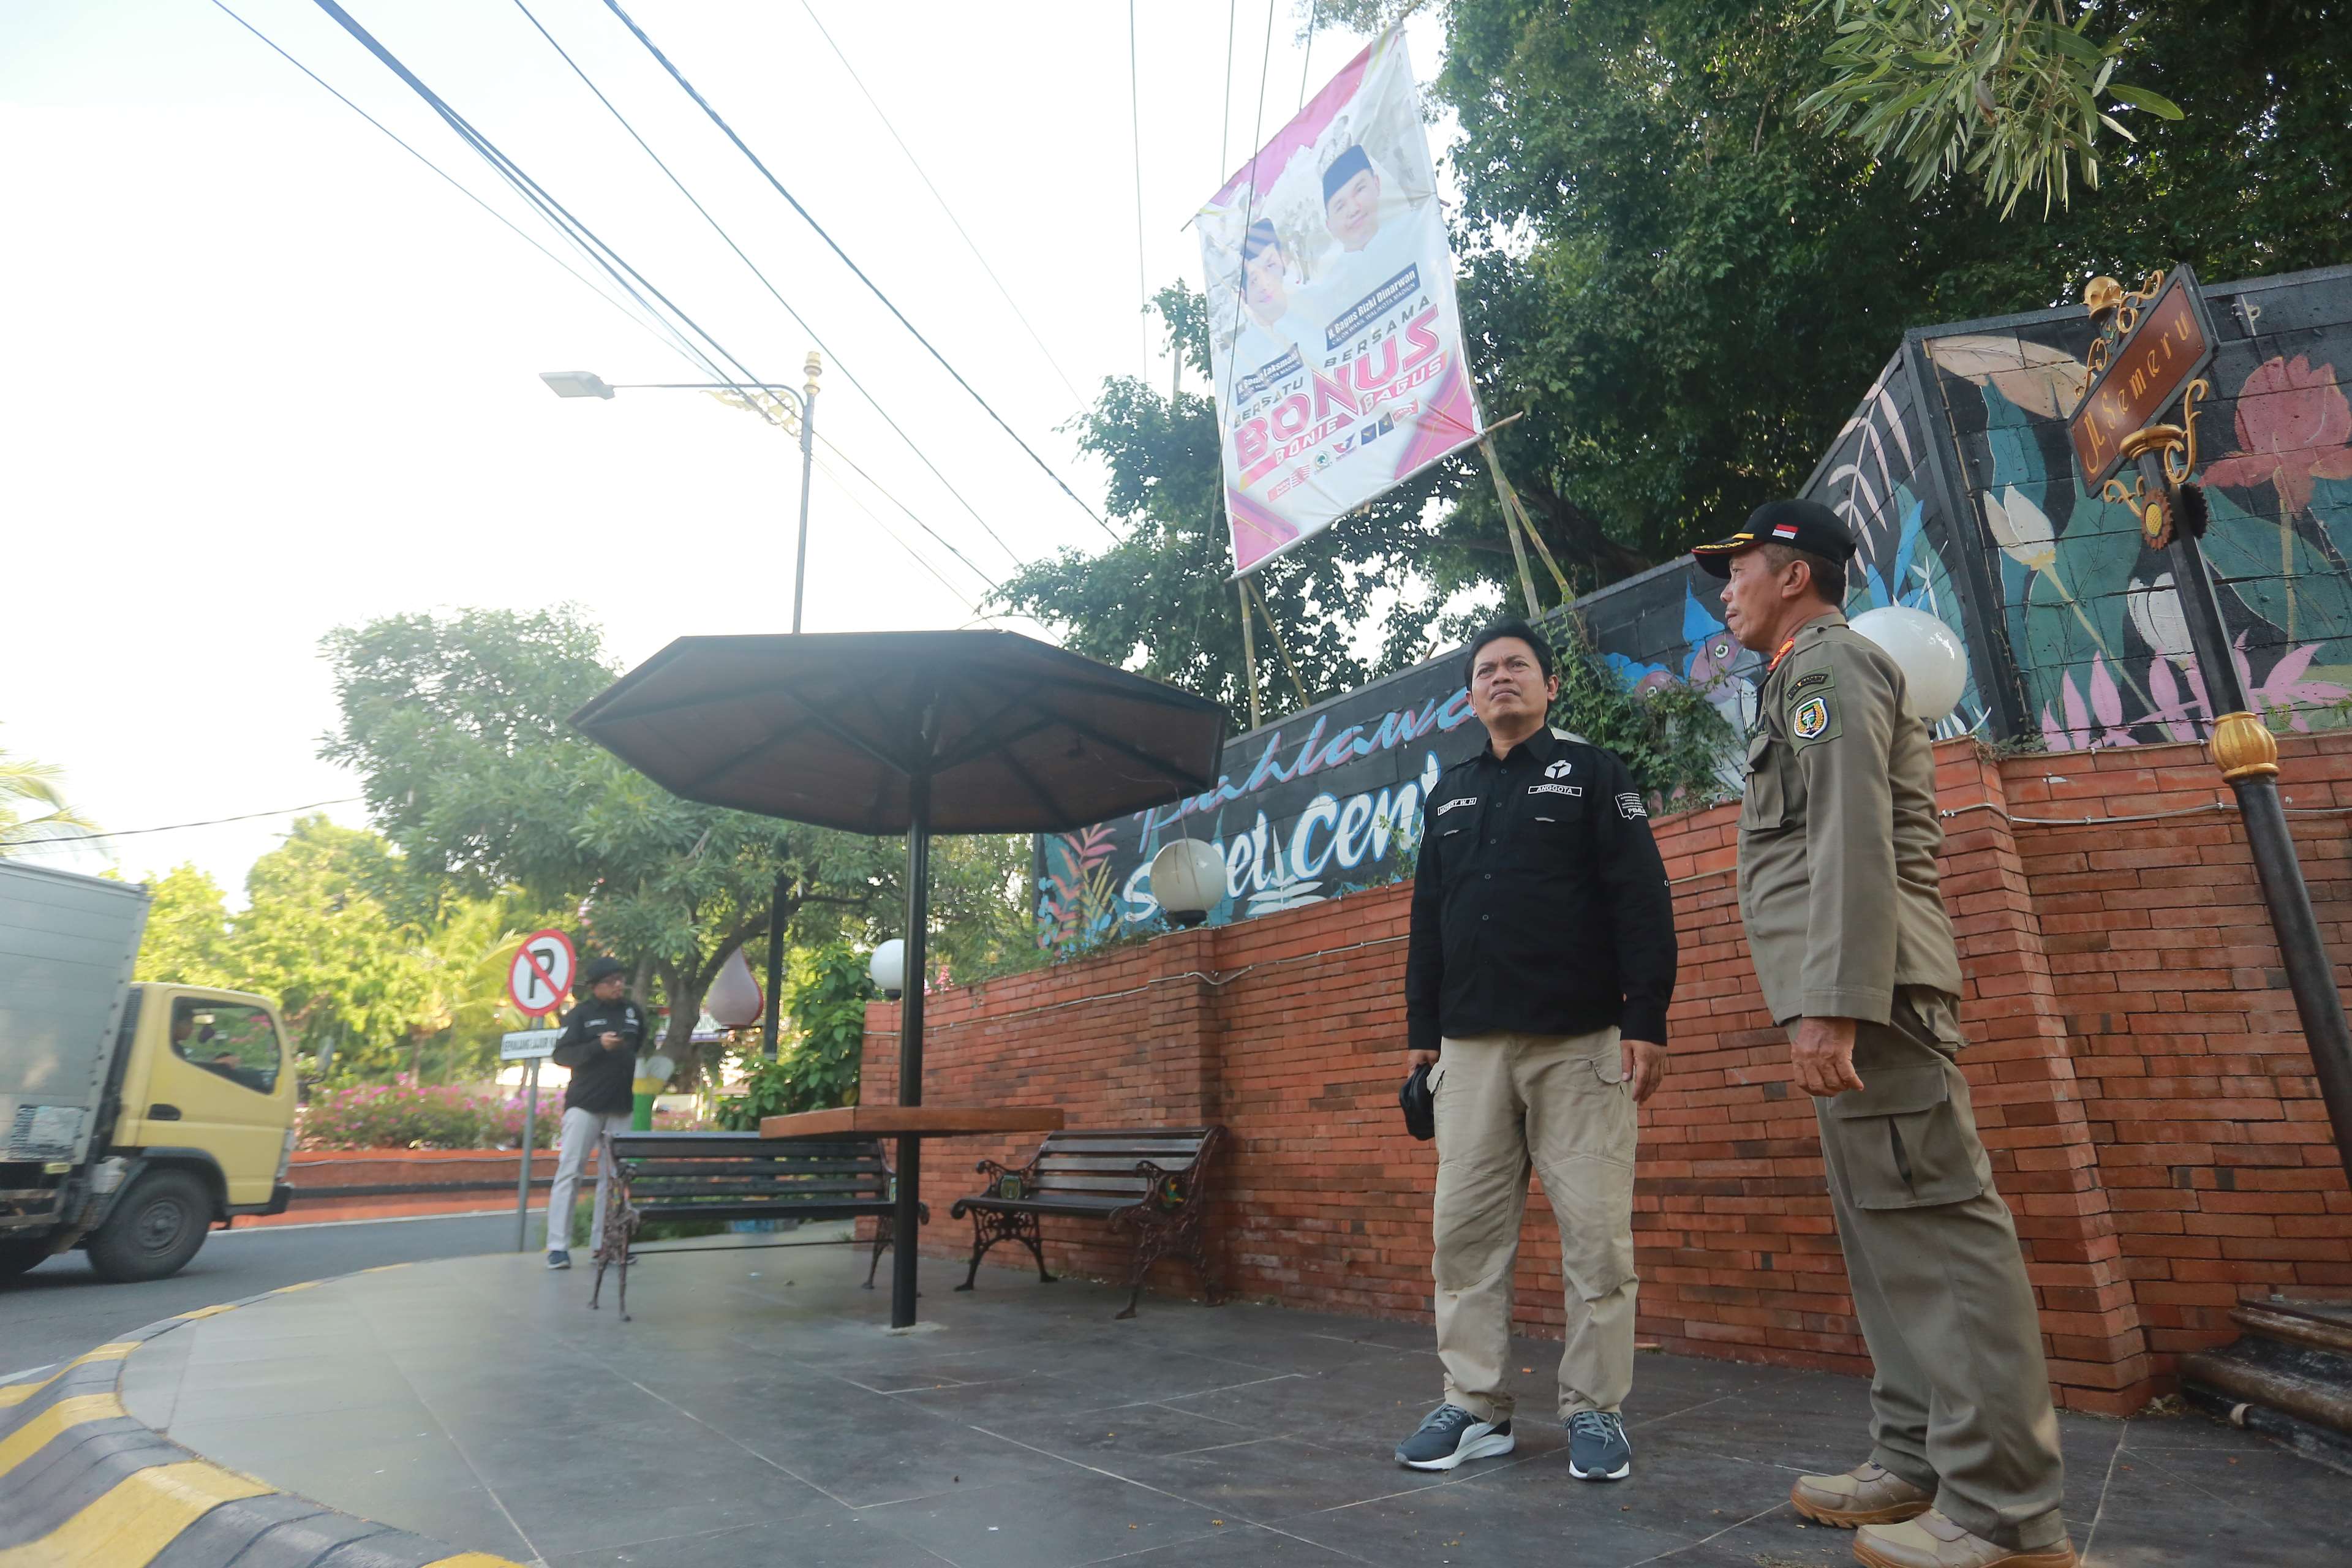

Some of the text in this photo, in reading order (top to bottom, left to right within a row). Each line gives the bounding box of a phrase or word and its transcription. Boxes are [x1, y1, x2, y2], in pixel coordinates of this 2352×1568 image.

[1334, 311, 1359, 334] Bagus
[1357, 296, 1378, 317] Rizki
[1376, 270, 1416, 303] Dinarwan
[1324, 295, 1430, 368] BERSAMA
[1233, 303, 1439, 471] BONUS
[1364, 355, 1442, 413] BAGUS
[2101, 311, 2192, 430] Semeru
[1234, 376, 1303, 428] BERSATU
[1275, 417, 1338, 466] BONIE
[1536, 785, 1573, 794] ANGGOTA
[529, 949, 555, 999] P
